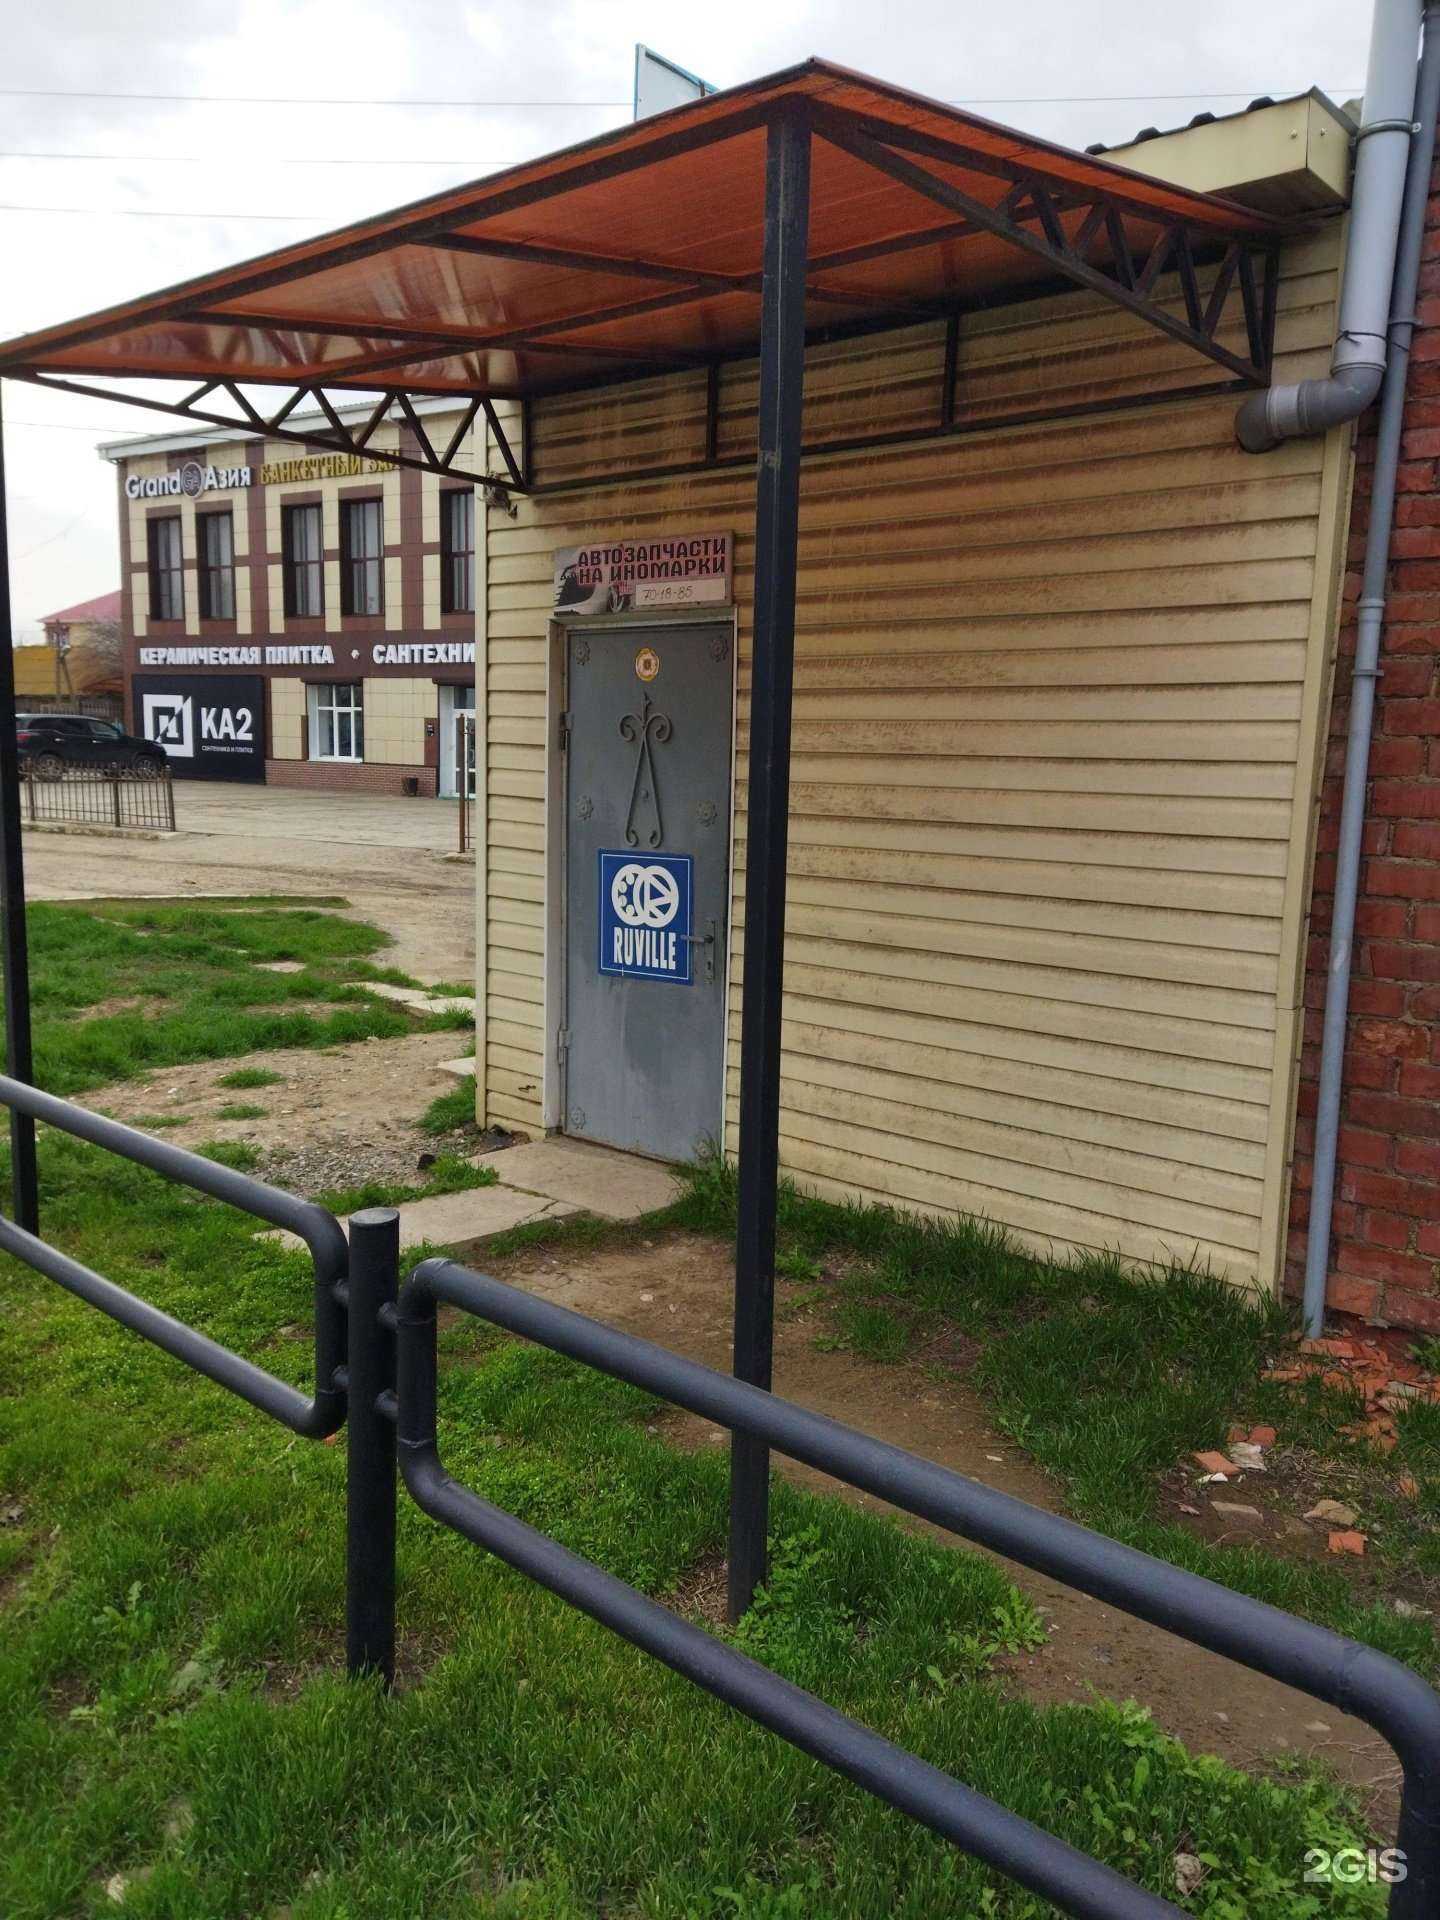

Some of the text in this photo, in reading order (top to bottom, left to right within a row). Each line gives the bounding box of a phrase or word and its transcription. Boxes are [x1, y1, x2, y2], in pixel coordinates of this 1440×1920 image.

[126, 468, 181, 498] Grand
[203, 465, 251, 490] Азия
[578, 538, 726, 567] АВТОЗАПЧАСТИ
[578, 556, 726, 585] НА ИНОМАРКИ
[139, 646, 262, 665] КЕРАМИЧЕСКАЯ
[265, 645, 335, 665] ПЛИТКА
[613, 926, 677, 970] RUVILLE
